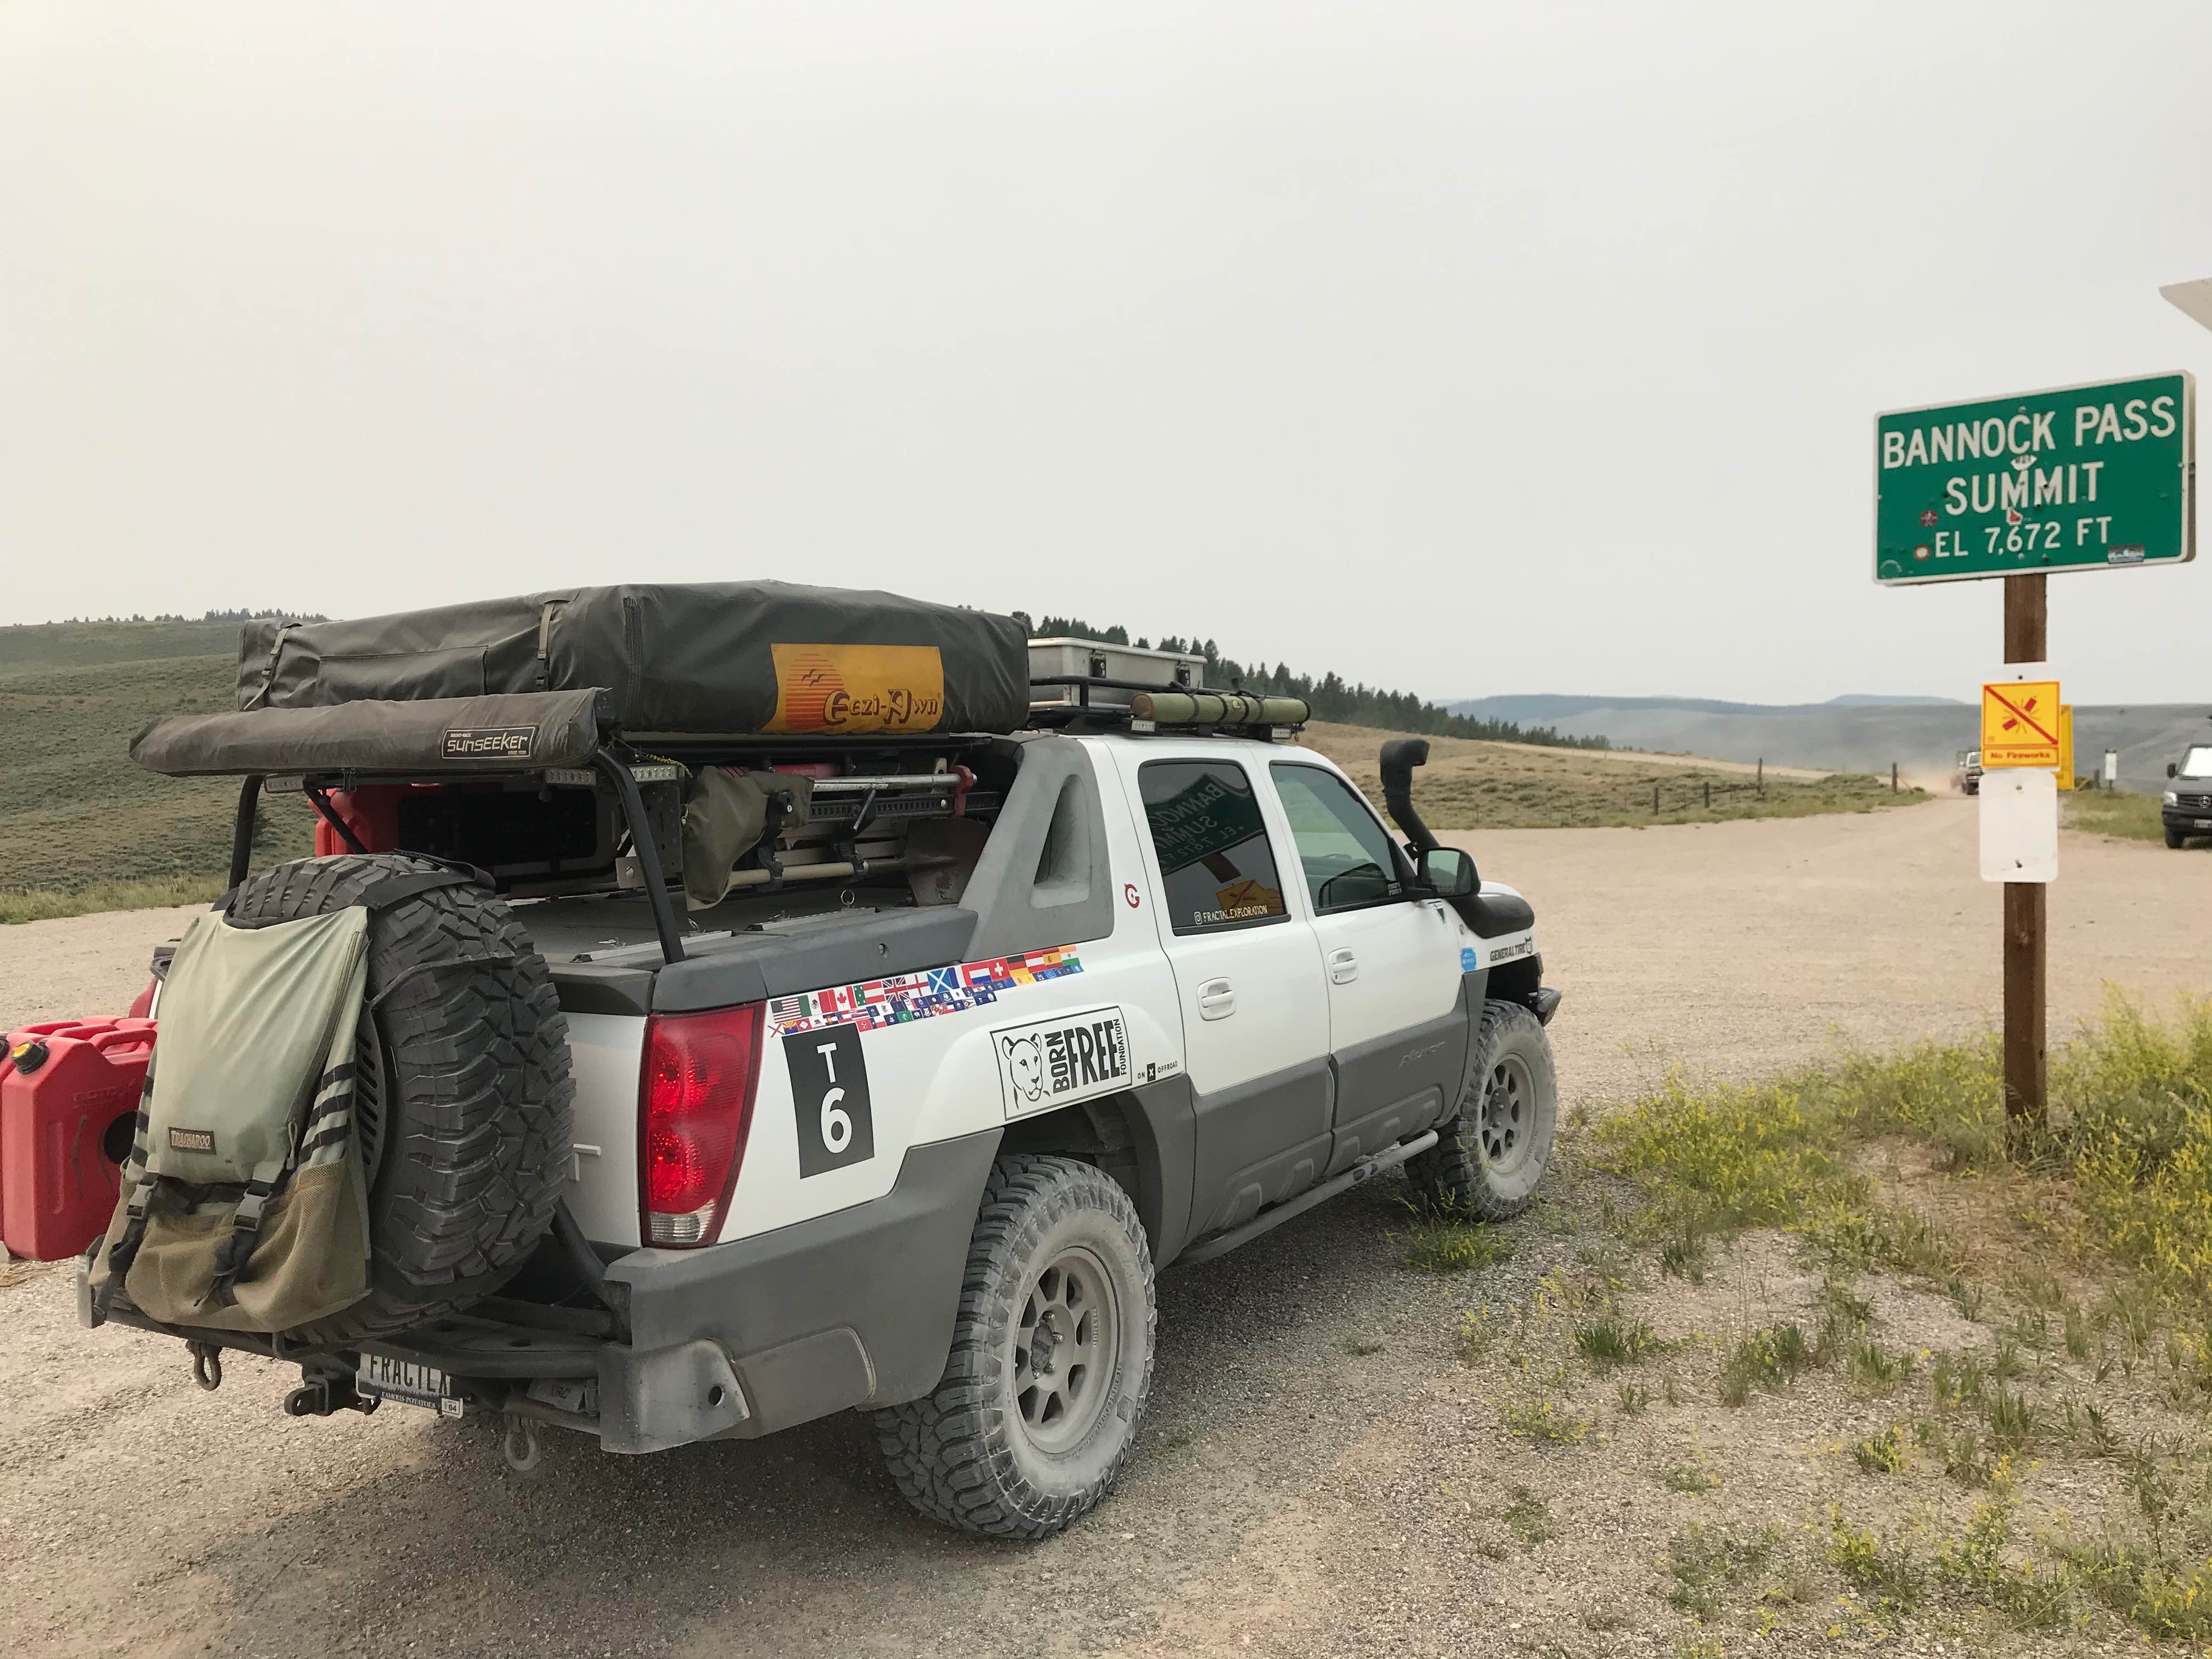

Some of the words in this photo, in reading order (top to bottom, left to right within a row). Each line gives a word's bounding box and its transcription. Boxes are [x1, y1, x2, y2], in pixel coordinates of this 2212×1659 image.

[1883, 410, 2056, 469] BANNOCK
[2075, 396, 2176, 447] PASS
[1945, 462, 2104, 515] SUMMIT
[1935, 531, 1968, 558] EL
[1984, 522, 2061, 556] 7,672
[2076, 517, 2112, 546] FT
[823, 689, 938, 726] Eezi-Awn
[2006, 751, 2051, 759] Fireworks
[1490, 946, 1514, 961] GENERAL
[1515, 943, 1526, 955] TIRE
[1045, 1030, 1070, 1093] BORN
[1063, 1020, 1120, 1089] FREE
[1113, 1018, 1127, 1075] FOUNDATION
[1158, 1060, 1178, 1074] OFFROAD
[382, 1391, 405, 1401] FAMOUS
[405, 1396, 436, 1409] POTATOES
